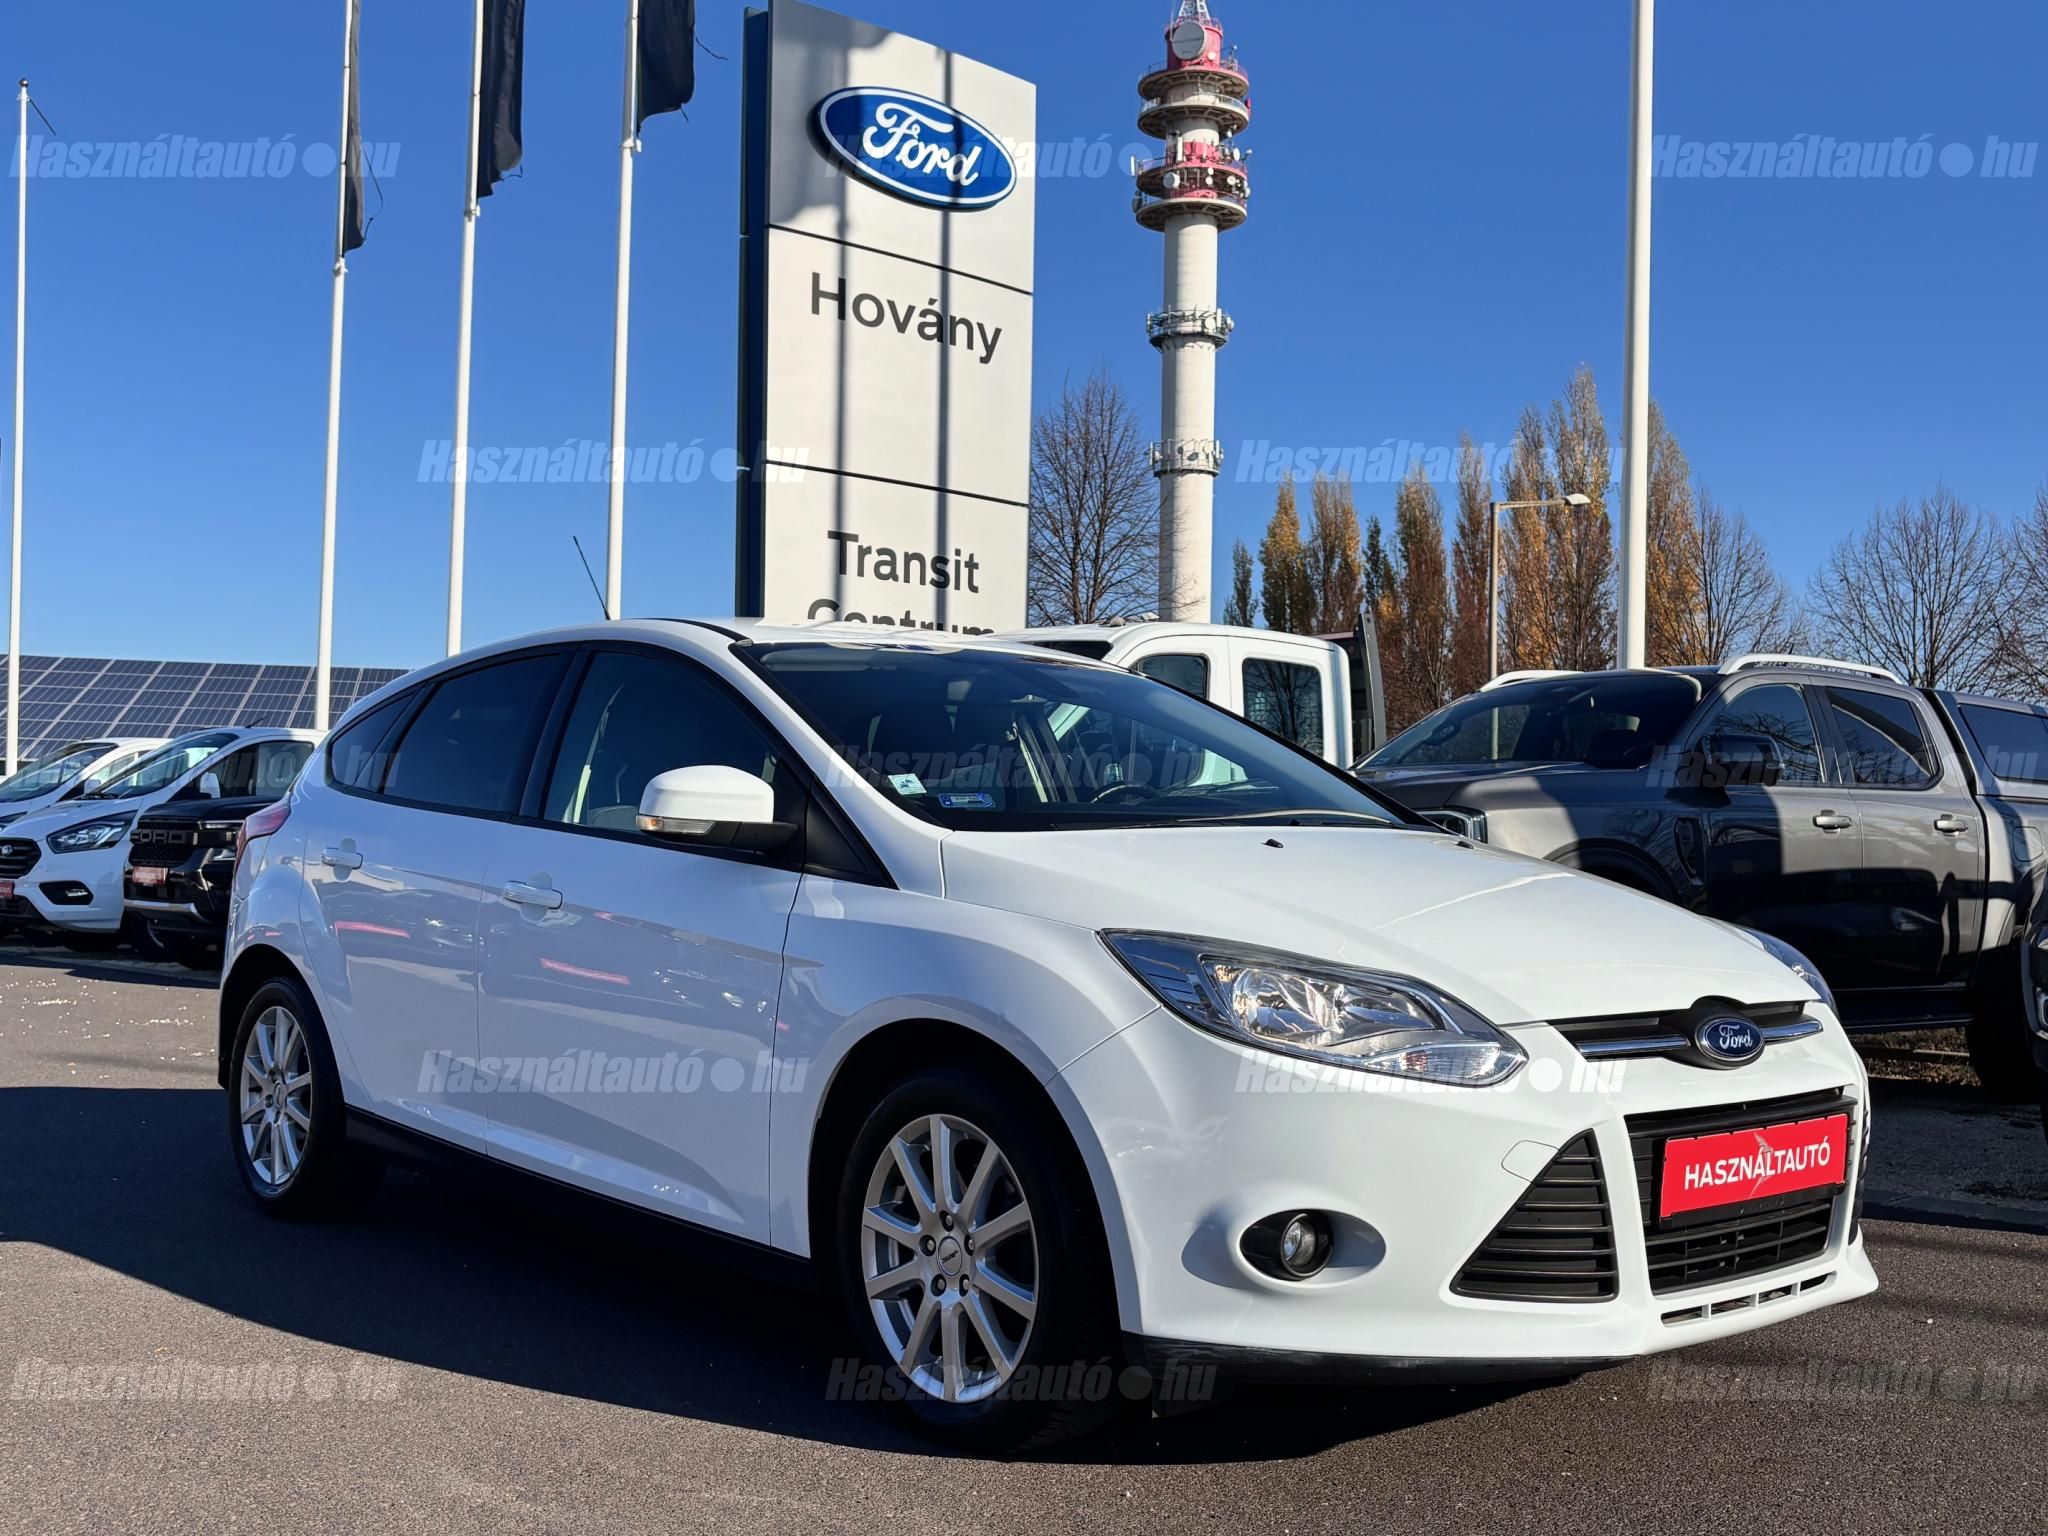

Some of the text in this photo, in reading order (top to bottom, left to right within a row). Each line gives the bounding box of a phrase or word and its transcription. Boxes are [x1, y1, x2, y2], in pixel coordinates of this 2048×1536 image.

[862, 102, 982, 186] Ford
[811, 272, 1002, 364] Hovány
[827, 530, 980, 593] Transit
[1719, 1025, 1753, 1049] Ford
[1684, 1136, 1830, 1190] HASZNÁLTAUTÓ
